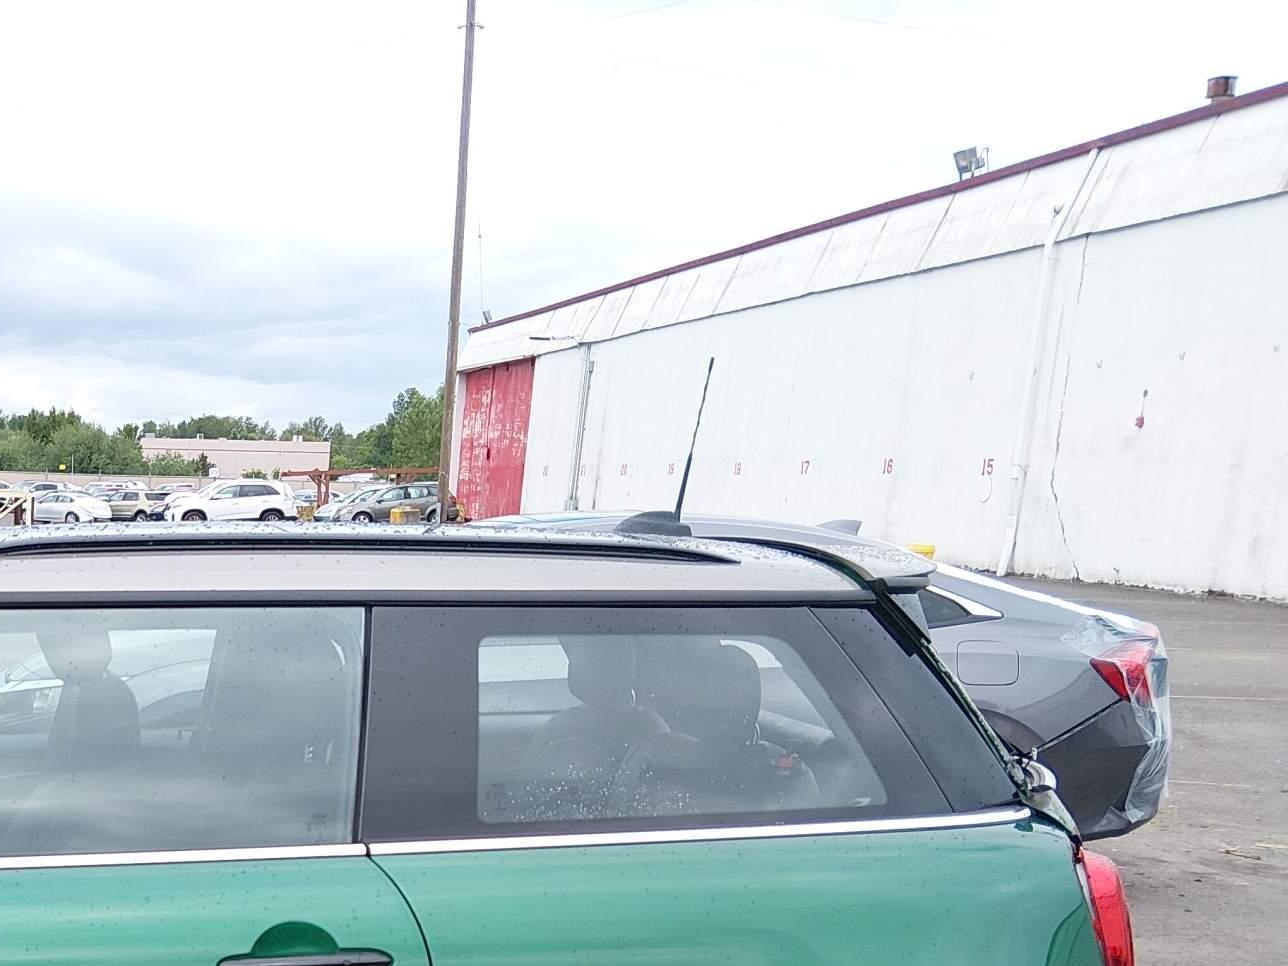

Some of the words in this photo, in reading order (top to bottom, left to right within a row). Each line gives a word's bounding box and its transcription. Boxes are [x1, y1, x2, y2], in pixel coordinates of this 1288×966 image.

[667, 463, 675, 475] 19
[733, 462, 741, 476] 18
[800, 460, 810, 475] 17
[882, 458, 893, 474] 16
[981, 458, 994, 476] 15
